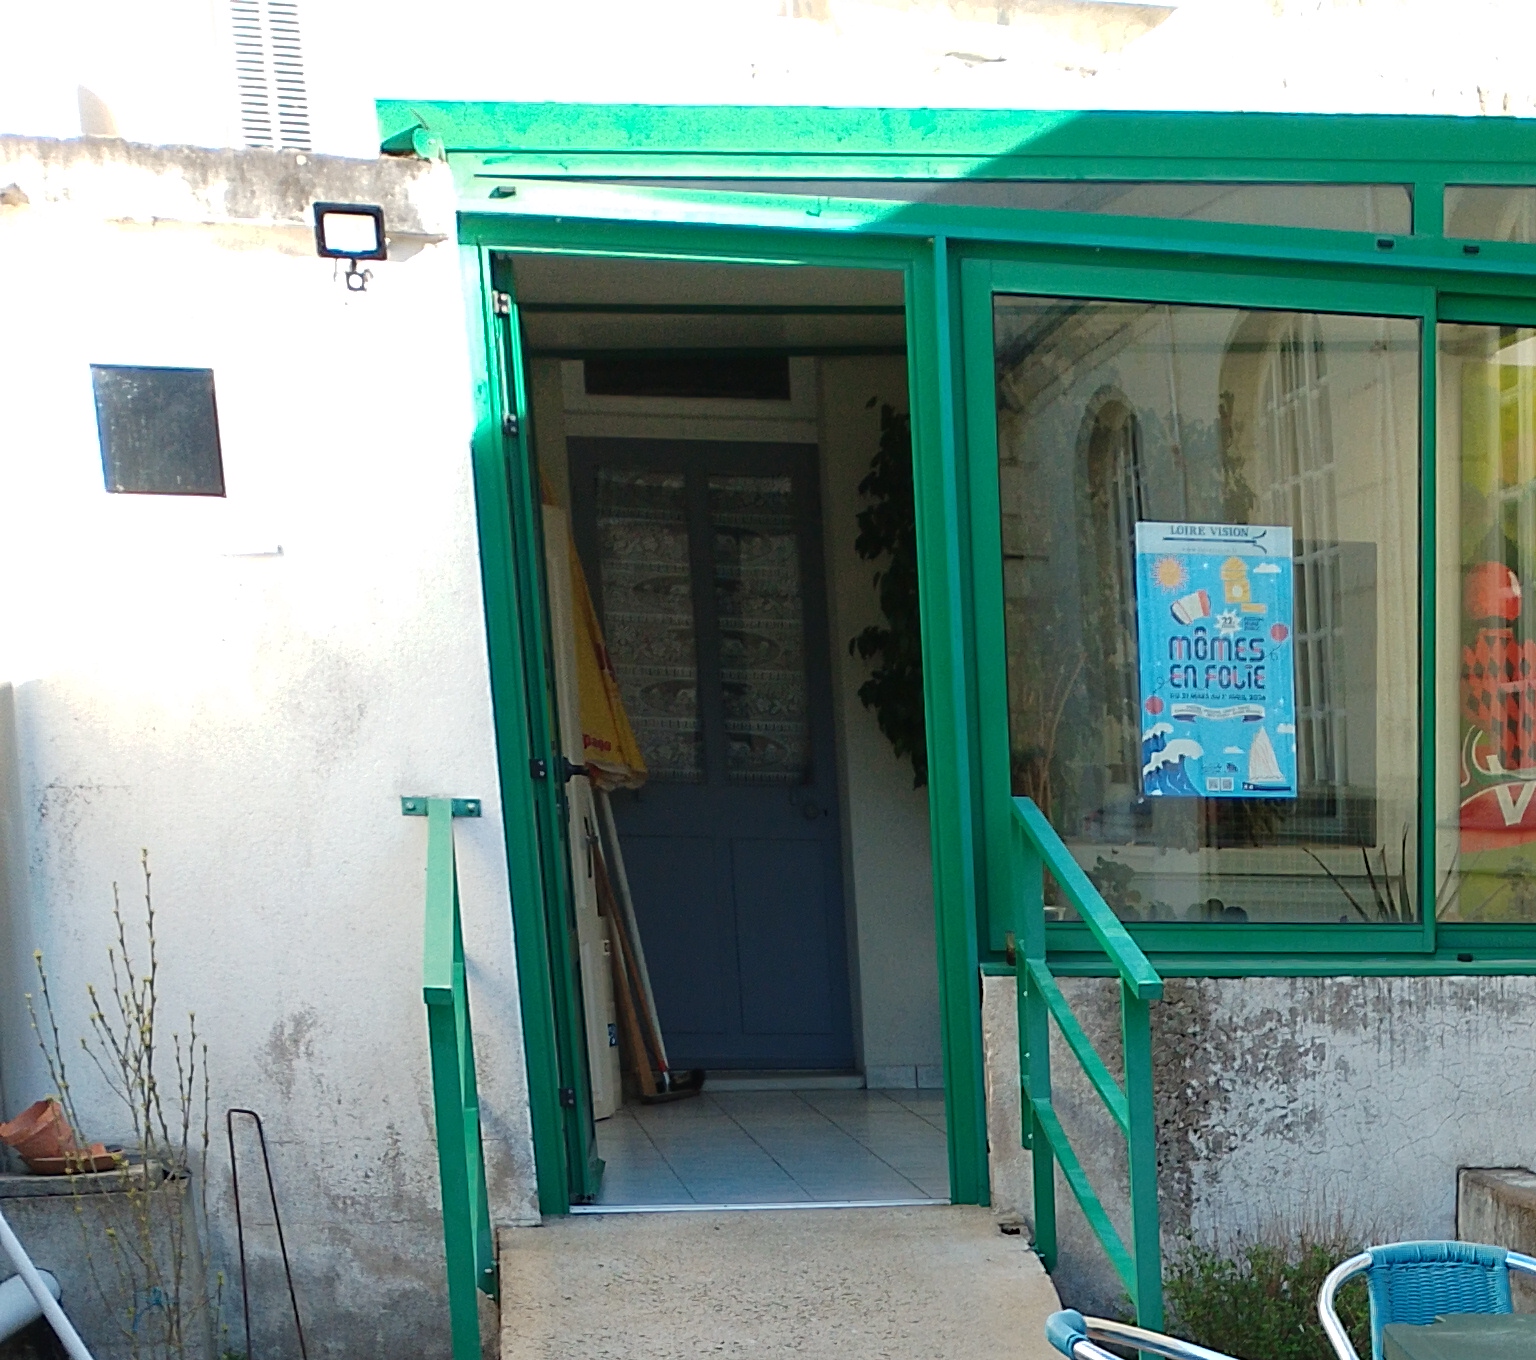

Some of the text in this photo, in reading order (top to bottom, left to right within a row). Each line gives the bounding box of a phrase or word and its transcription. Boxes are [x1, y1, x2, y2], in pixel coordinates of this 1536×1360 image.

[1170, 525, 1249, 537] LOIRE VISION
[1169, 626, 1265, 662] MÔMES
[1170, 664, 1265, 690] EN FOLIE
